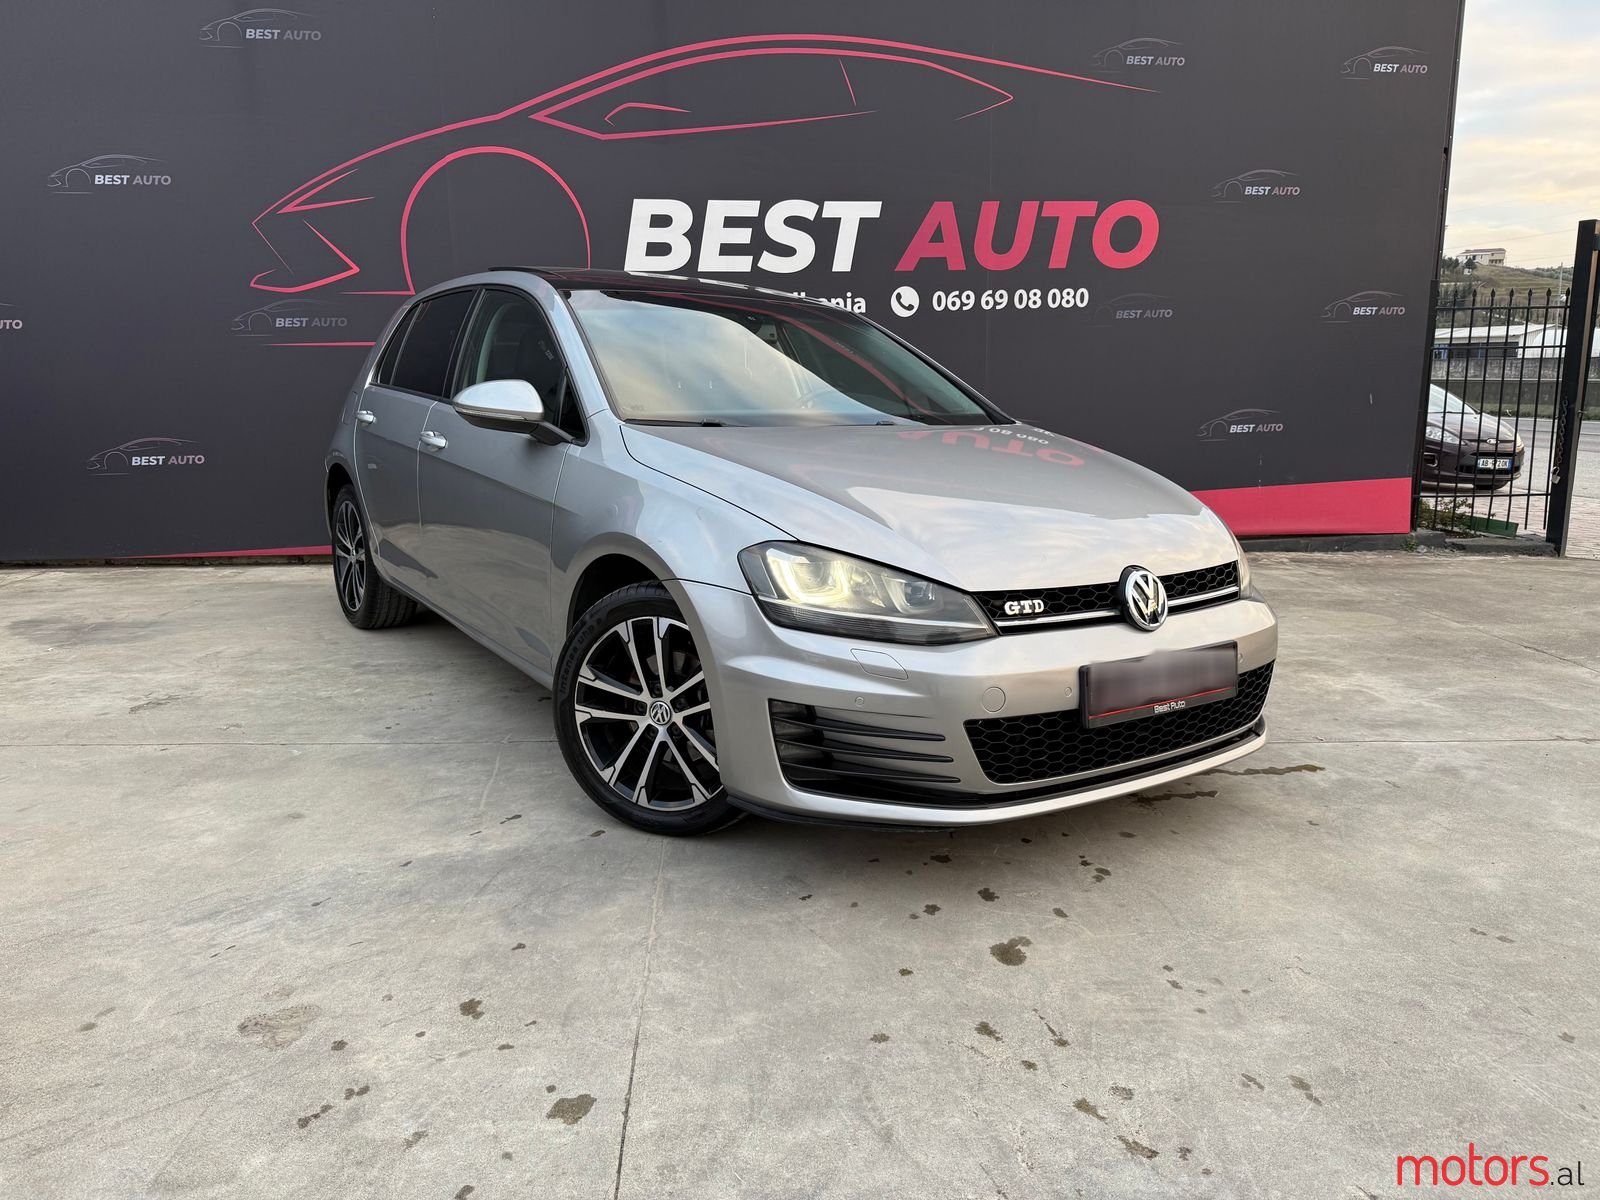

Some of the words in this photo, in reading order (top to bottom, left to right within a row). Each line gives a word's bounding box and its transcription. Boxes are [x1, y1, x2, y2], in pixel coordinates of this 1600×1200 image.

[245, 28, 281, 41] BEST
[284, 28, 322, 41] AUTO
[1126, 55, 1154, 67] BEST
[1155, 55, 1186, 67] AUTO
[1373, 63, 1399, 74] BEST
[1400, 63, 1428, 74] AUTO
[95, 174, 130, 185] BEST
[132, 174, 171, 185] AUTO
[1244, 185, 1271, 197] BEST
[1272, 185, 1301, 197] AUTO
[623, 198, 882, 275] BEST
[895, 199, 1160, 272] AUTO
[932, 289, 976, 313] 069
[980, 288, 1009, 311] 69
[1013, 287, 1042, 310] 08
[1047, 287, 1090, 309] 080
[1115, 309, 1143, 320] BEST
[1144, 309, 1173, 320] AUTO
[1353, 305, 1378, 316] BEST
[1379, 305, 1405, 316] AUTO
[276, 317, 308, 328] BEST
[311, 317, 347, 328] AUTO
[1229, 423, 1256, 434] BEST
[1256, 423, 1284, 434] AUTO
[131, 454, 166, 466] BEST
[168, 454, 205, 466] AUTO
[1004, 599, 1045, 616] GTD
[1154, 703, 1170, 714] Best
[1170, 700, 1186, 709] Auto
